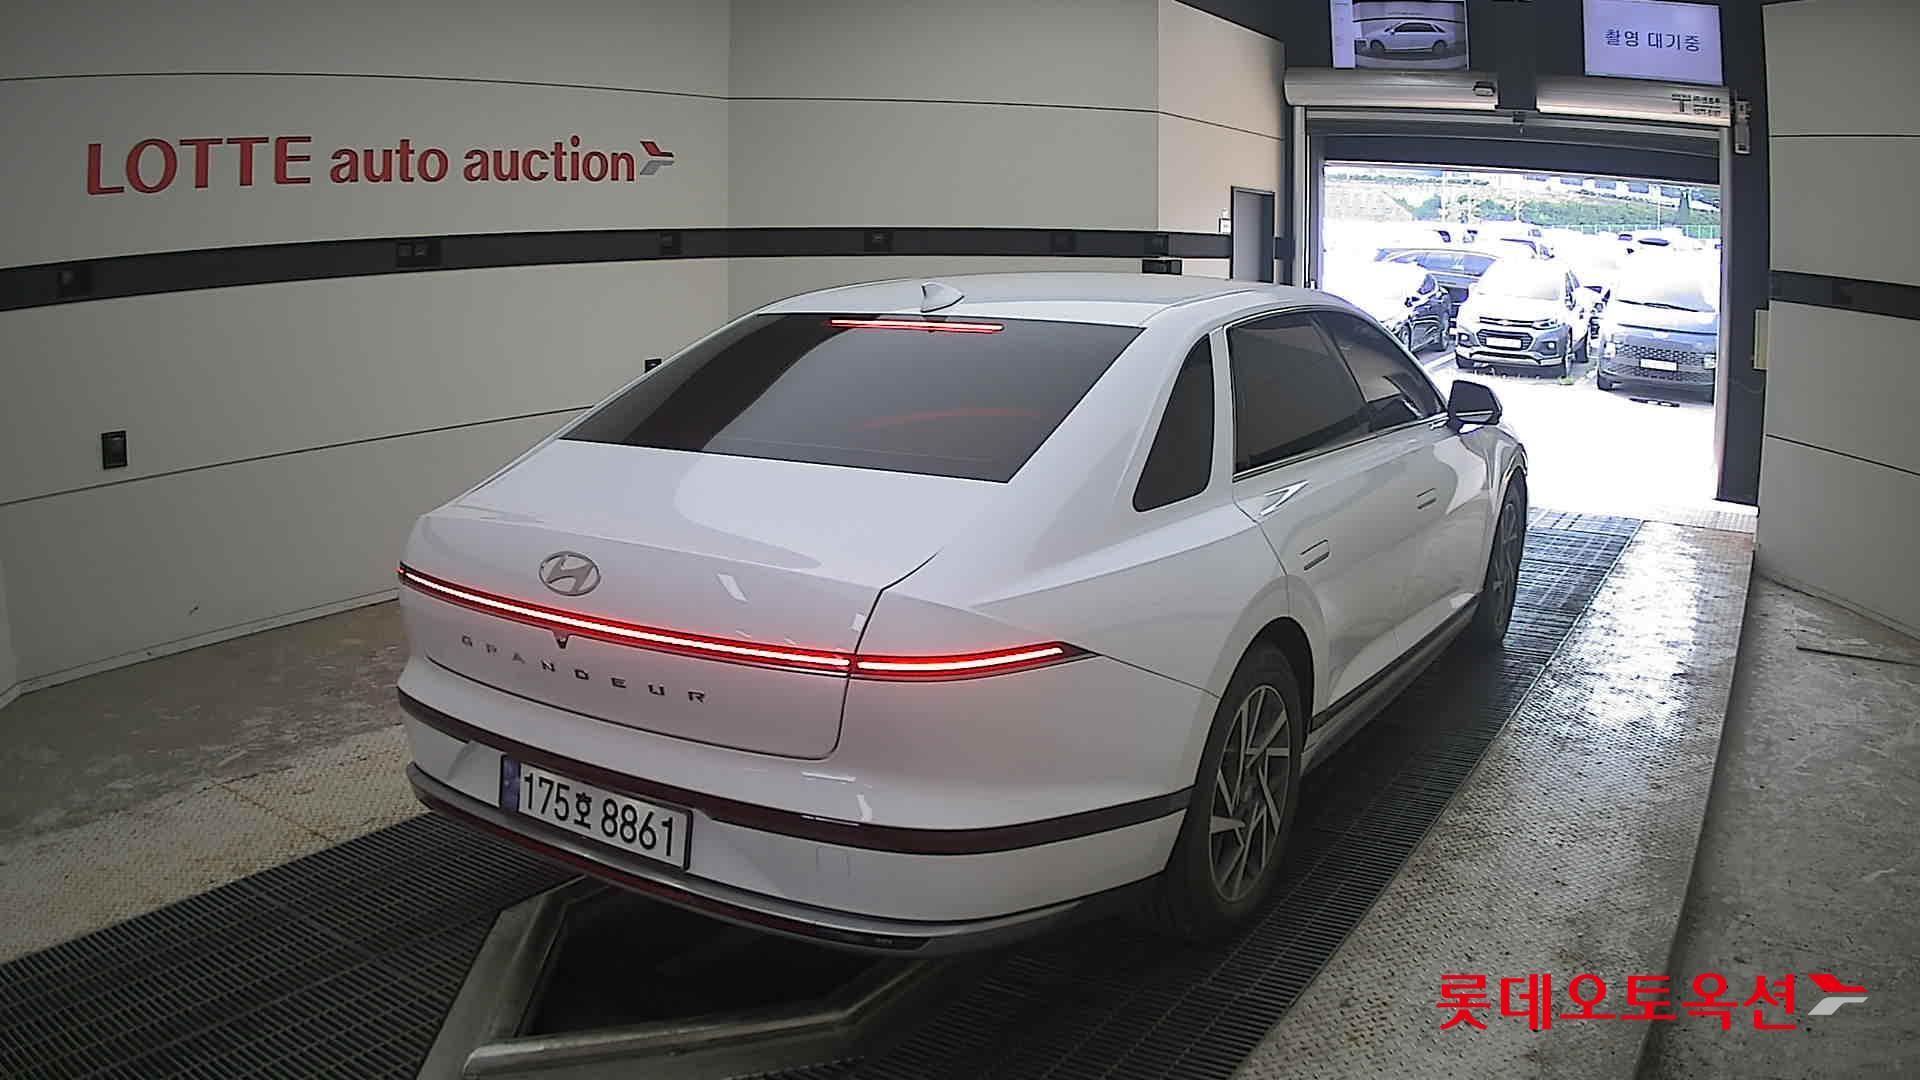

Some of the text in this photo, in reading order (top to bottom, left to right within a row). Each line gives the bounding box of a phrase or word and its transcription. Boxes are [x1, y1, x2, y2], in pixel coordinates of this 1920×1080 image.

[1605, 29, 1701, 52] 촬영 대기중
[87, 135, 637, 194] LOTTE auto auction
[461, 634, 706, 705] GRANDEUR
[600, 798, 674, 857] 8861
